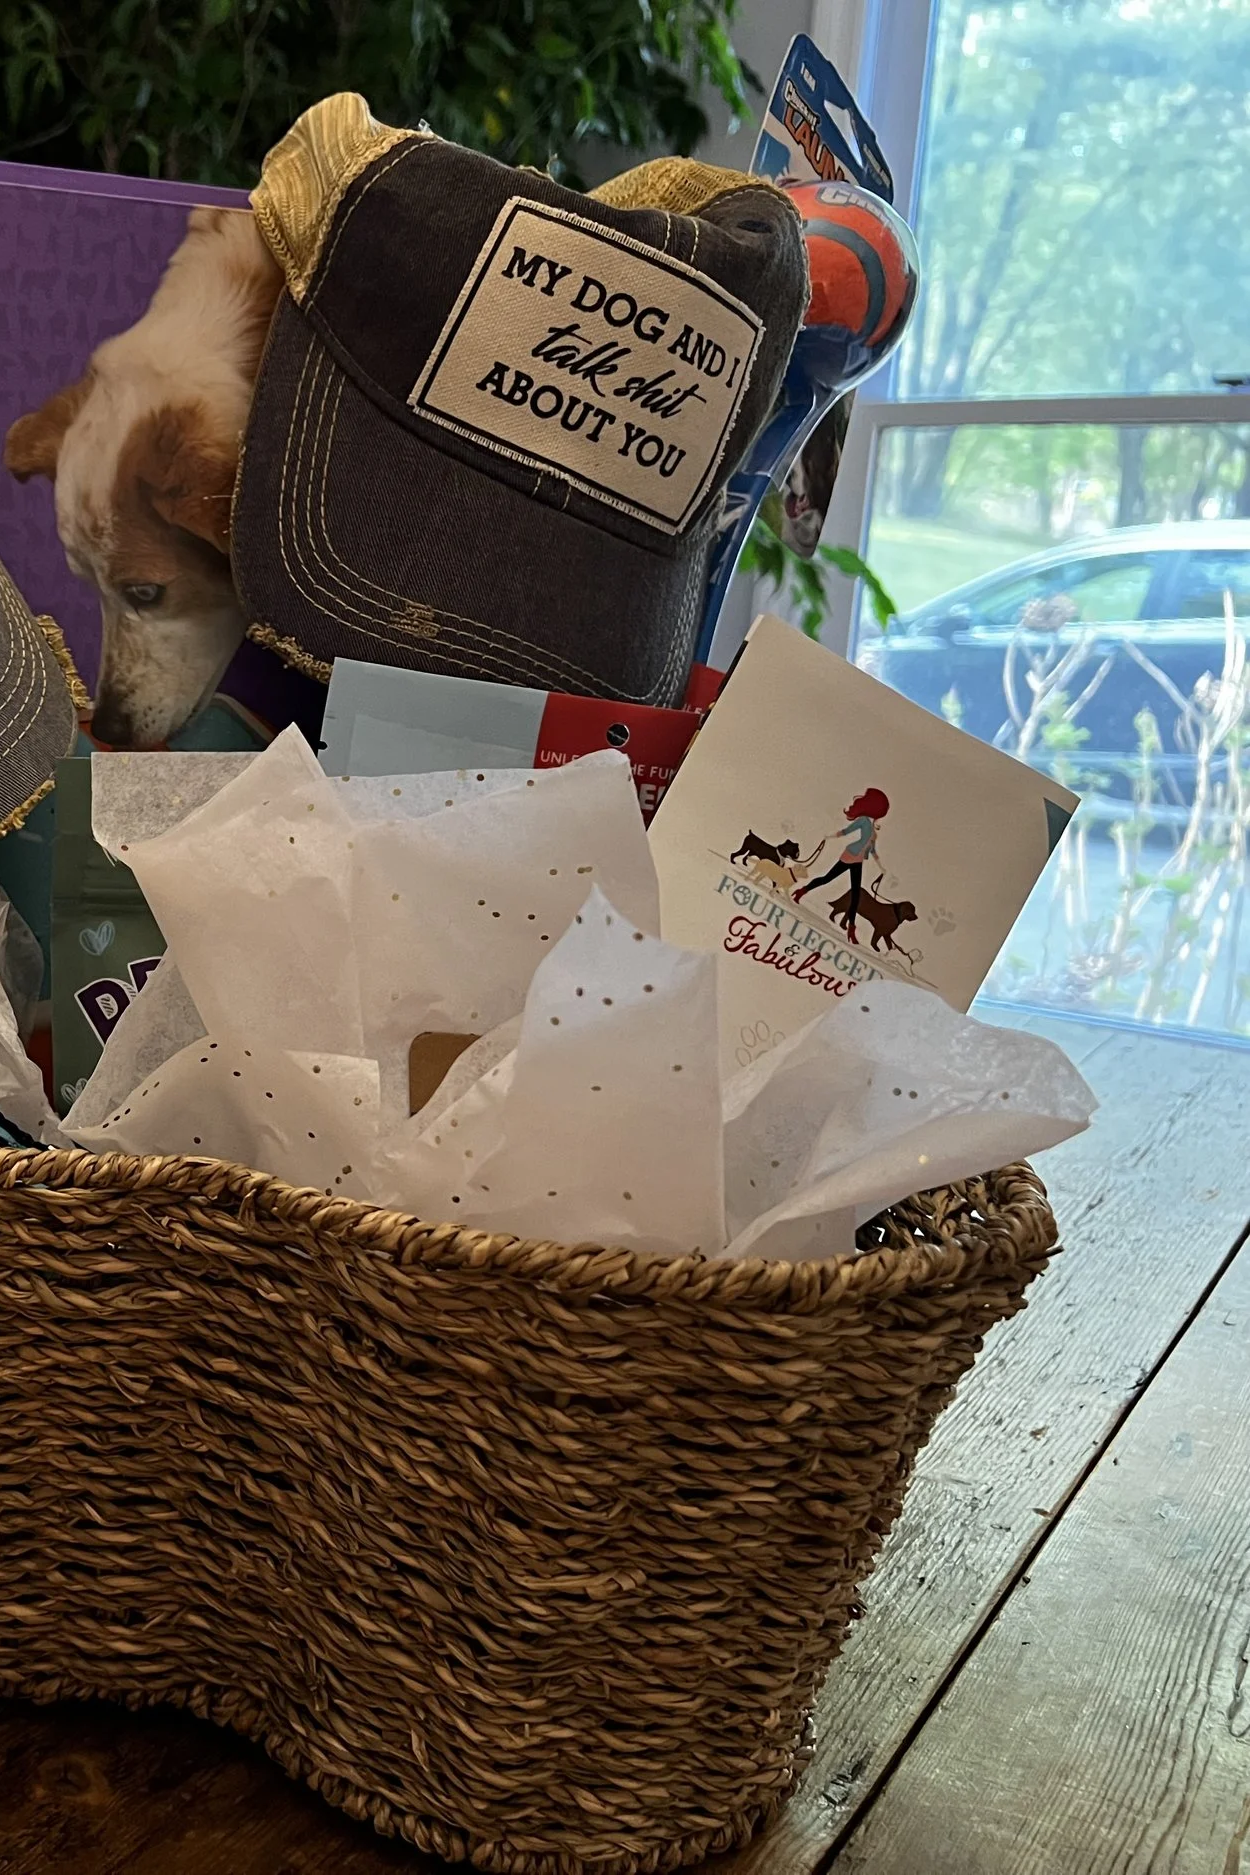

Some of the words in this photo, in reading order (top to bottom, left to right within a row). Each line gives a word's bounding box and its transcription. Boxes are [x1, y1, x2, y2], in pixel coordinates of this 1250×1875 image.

[501, 246, 571, 296] MY
[570, 275, 669, 344] DOG
[667, 324, 726, 377] AND
[725, 357, 740, 388] I
[475, 361, 616, 442] ABOUT
[617, 422, 686, 478] YOU
[531, 323, 631, 398] talk
[613, 369, 707, 419] shit
[713, 873, 789, 930] FOUR
